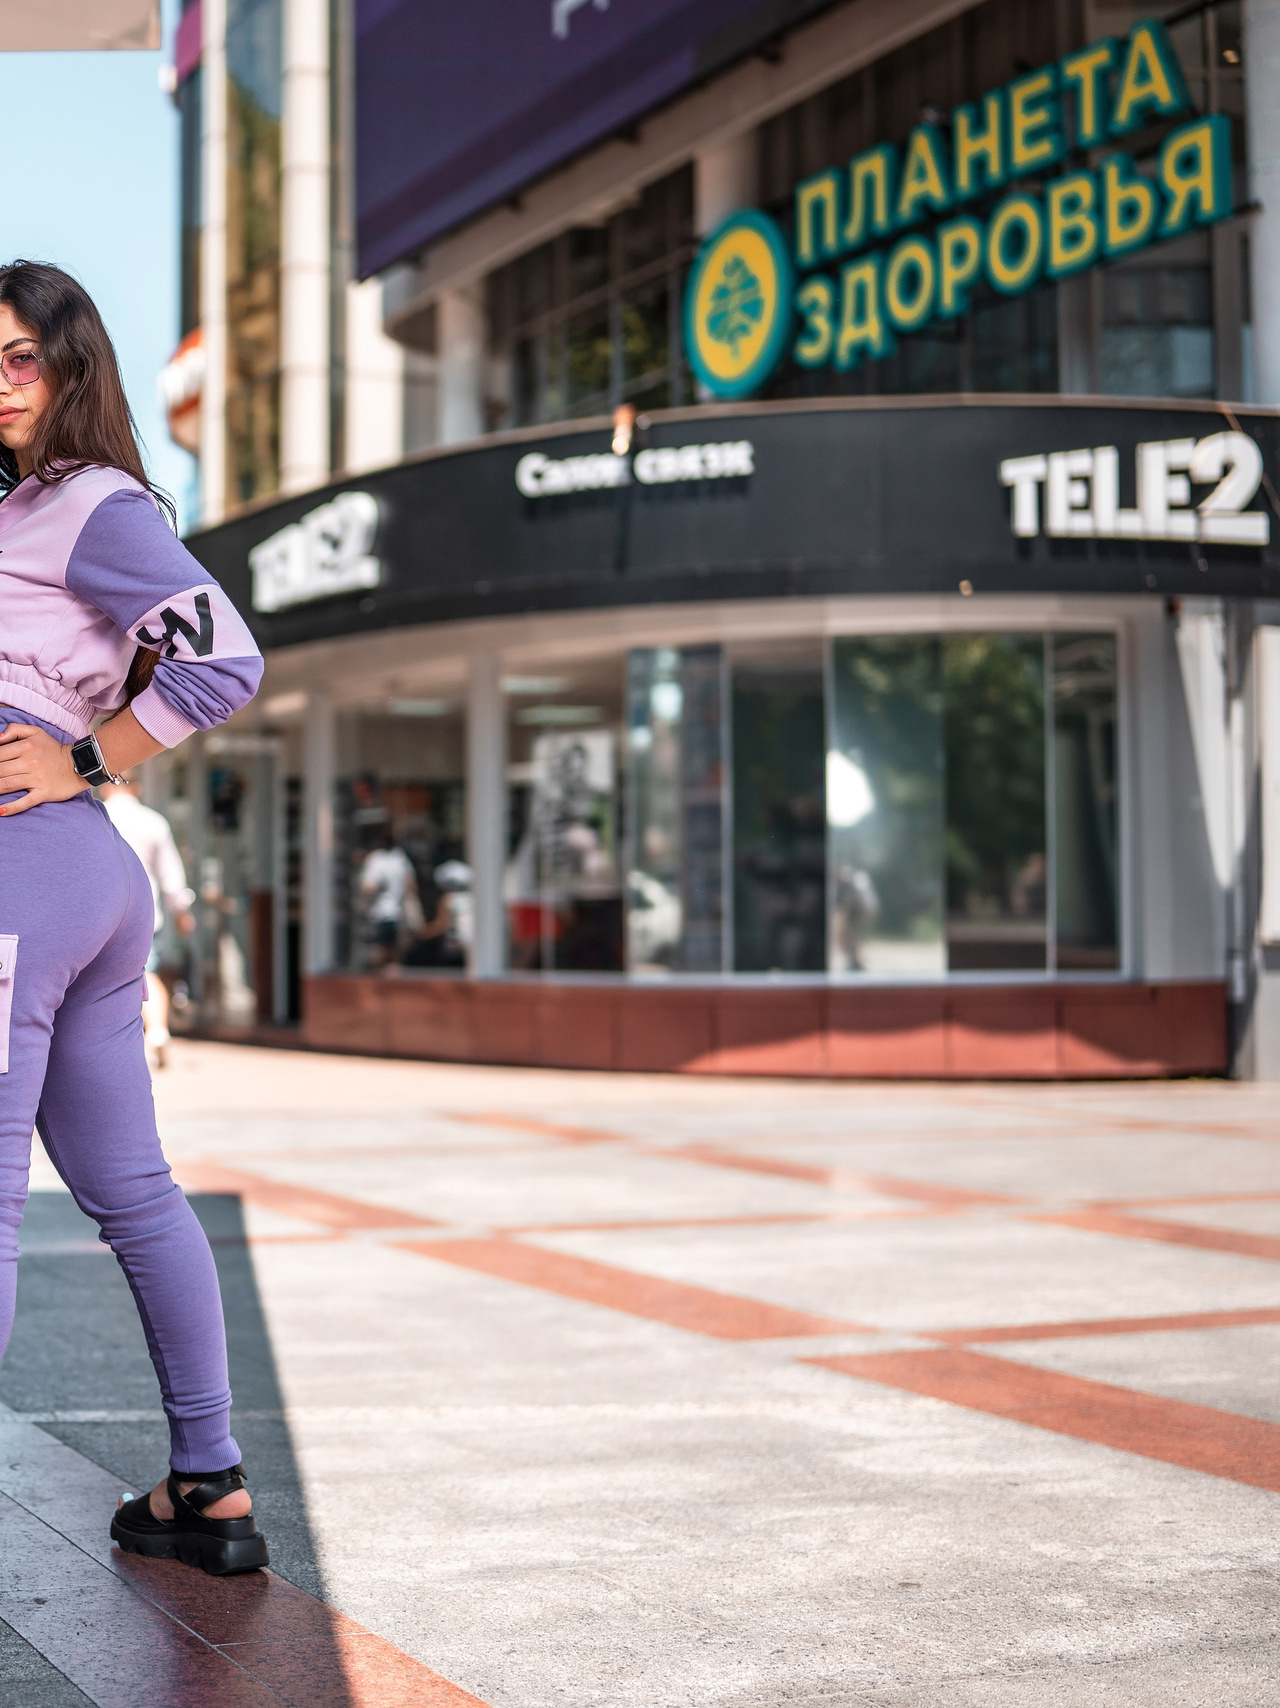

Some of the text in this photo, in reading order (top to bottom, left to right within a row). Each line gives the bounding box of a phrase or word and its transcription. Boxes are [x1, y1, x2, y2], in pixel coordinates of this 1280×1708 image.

[796, 21, 1186, 267] ПЛАНЕТА
[796, 115, 1229, 371] ЗДОРОВЬЯ
[999, 431, 1270, 546] TELE2
